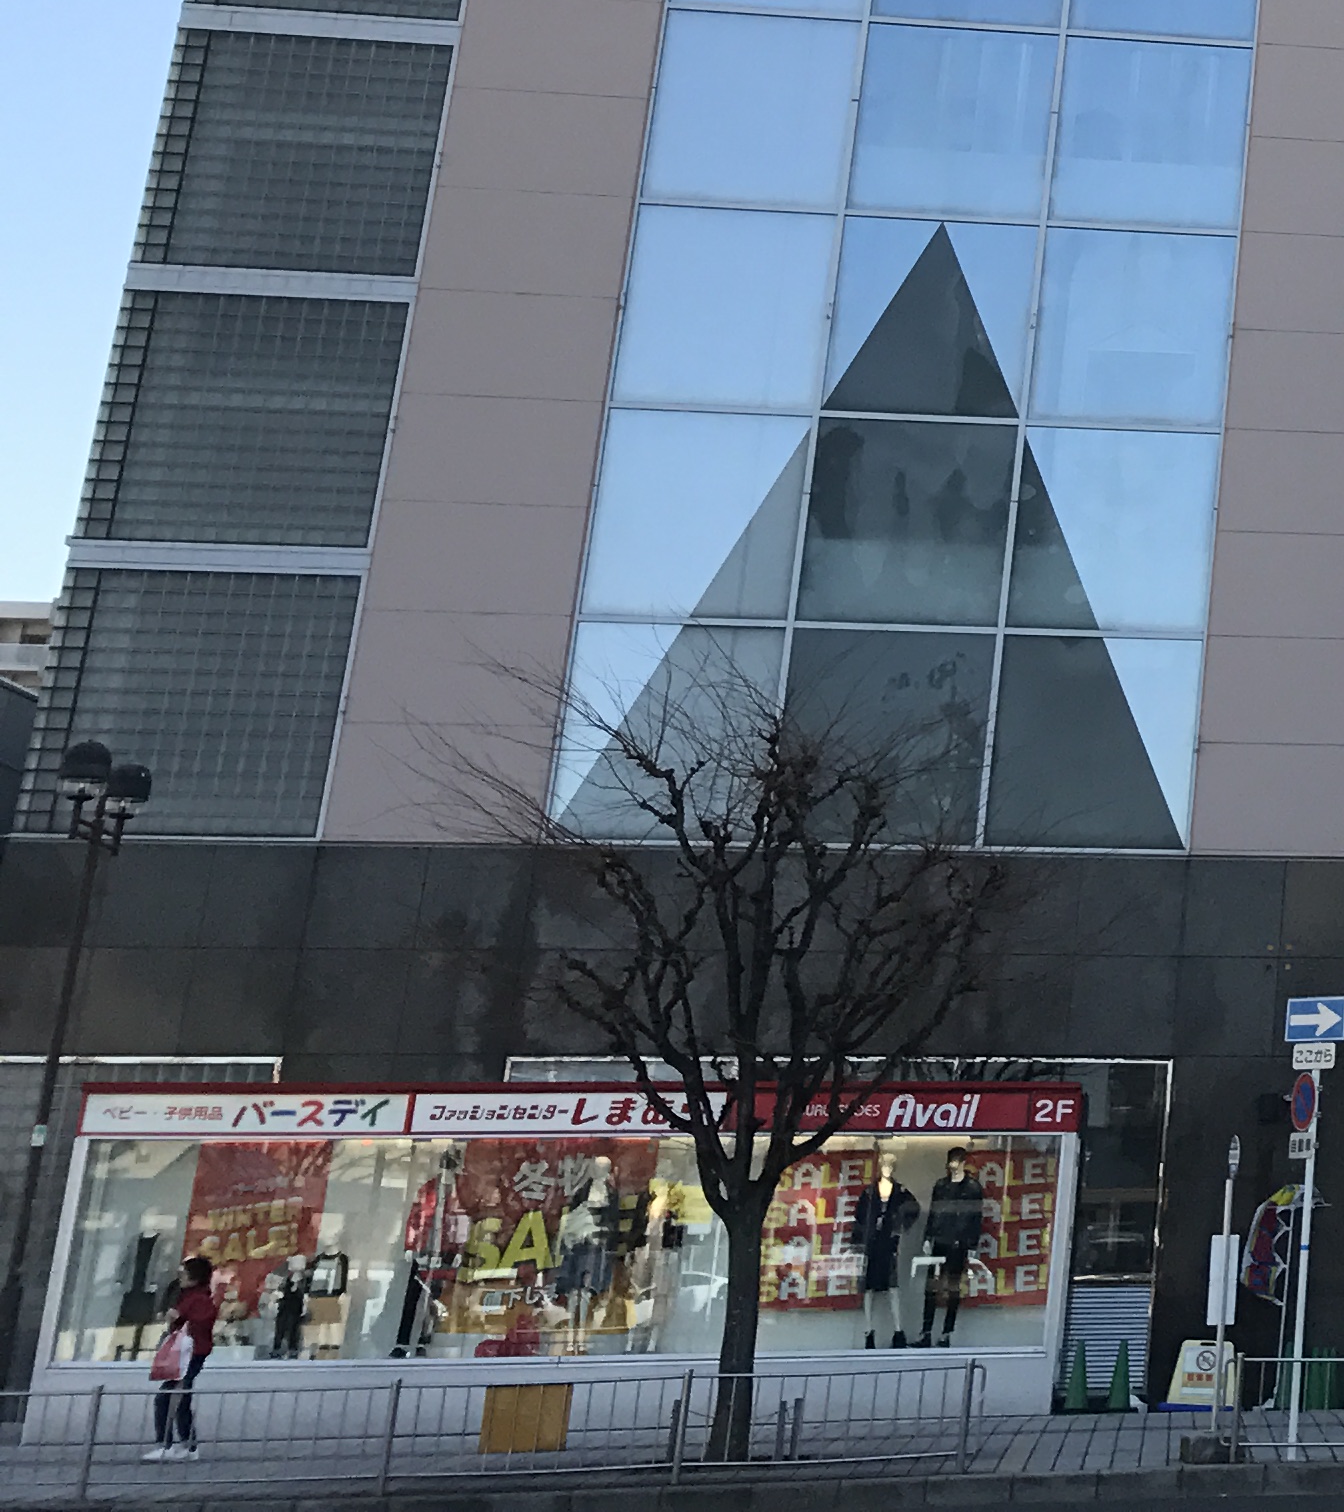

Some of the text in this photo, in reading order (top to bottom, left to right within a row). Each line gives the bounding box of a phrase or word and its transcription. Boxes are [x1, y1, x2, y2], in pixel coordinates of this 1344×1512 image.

[1295, 1049, 1333, 1063] ここから
[429, 1104, 569, 1121] ファッションセンター
[885, 1093, 982, 1128] Avail
[1034, 1099, 1076, 1123] 2F
